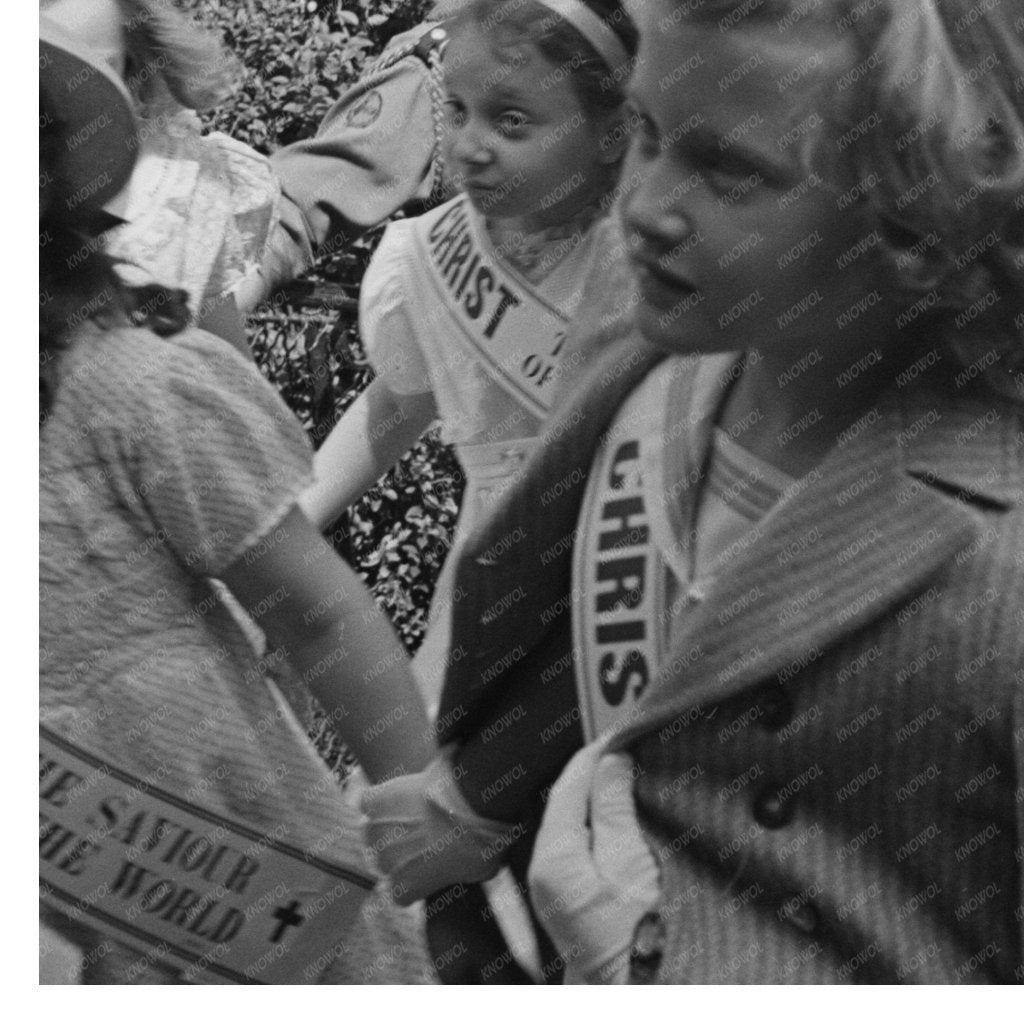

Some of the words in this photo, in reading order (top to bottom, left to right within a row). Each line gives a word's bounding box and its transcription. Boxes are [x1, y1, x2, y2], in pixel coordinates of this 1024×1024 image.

[429, 199, 520, 340] CHRIST
[85, 794, 261, 896] SAVIOUR
[110, 860, 247, 944] WORLD
